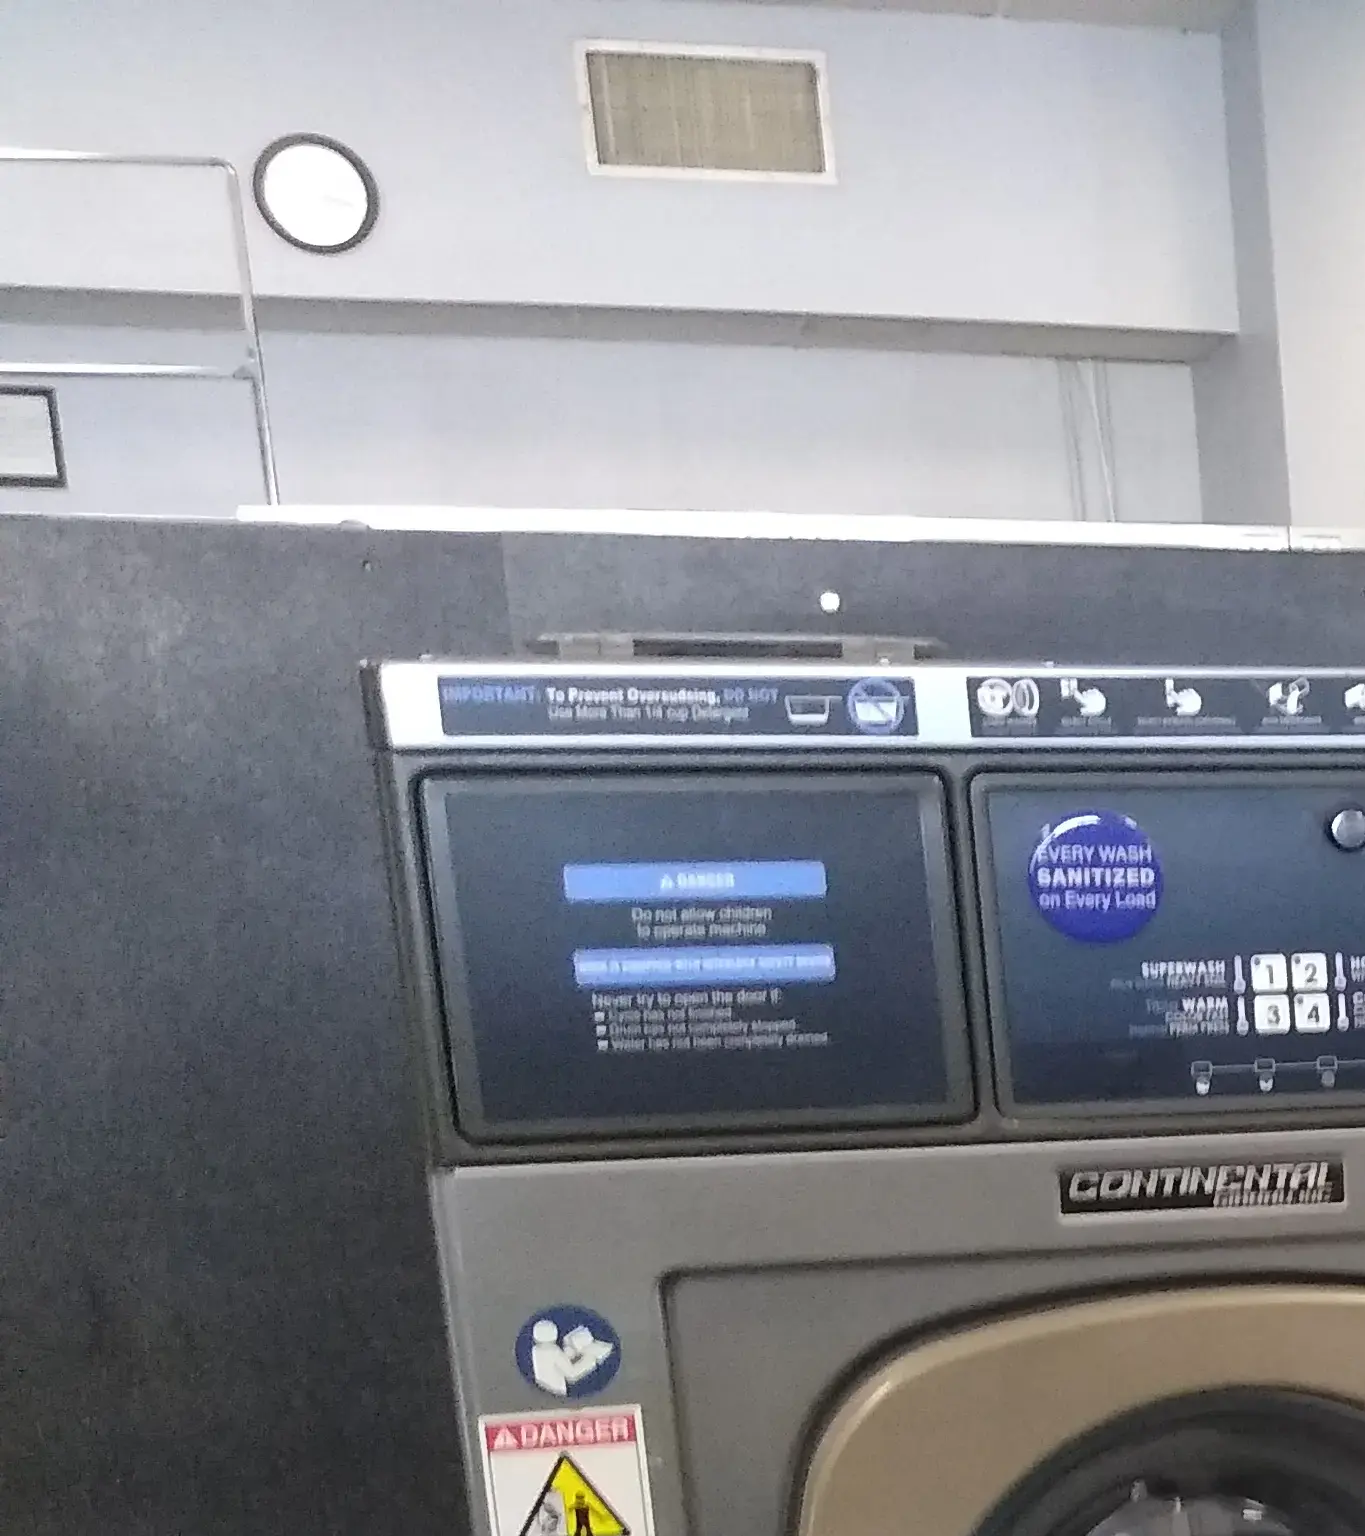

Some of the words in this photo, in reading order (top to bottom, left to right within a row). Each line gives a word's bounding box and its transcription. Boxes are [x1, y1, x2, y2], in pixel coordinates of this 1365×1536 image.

[547, 687, 565, 703] To
[1036, 844, 1097, 865] EVERY
[1099, 843, 1154, 866] WASH
[1036, 867, 1156, 889] SANITIZED
[1038, 891, 1062, 911] on
[1063, 888, 1113, 913] Every
[1115, 887, 1158, 911] Load
[1140, 959, 1226, 979] SUPERWASH
[1265, 964, 1275, 985] 1
[1304, 962, 1318, 984] 2
[1181, 995, 1229, 1015] WARM
[1267, 1003, 1281, 1026] 3
[1307, 1002, 1320, 1024] 4
[1068, 1161, 1333, 1202] CONTINENTAL
[520, 1415, 629, 1447] DANGER
